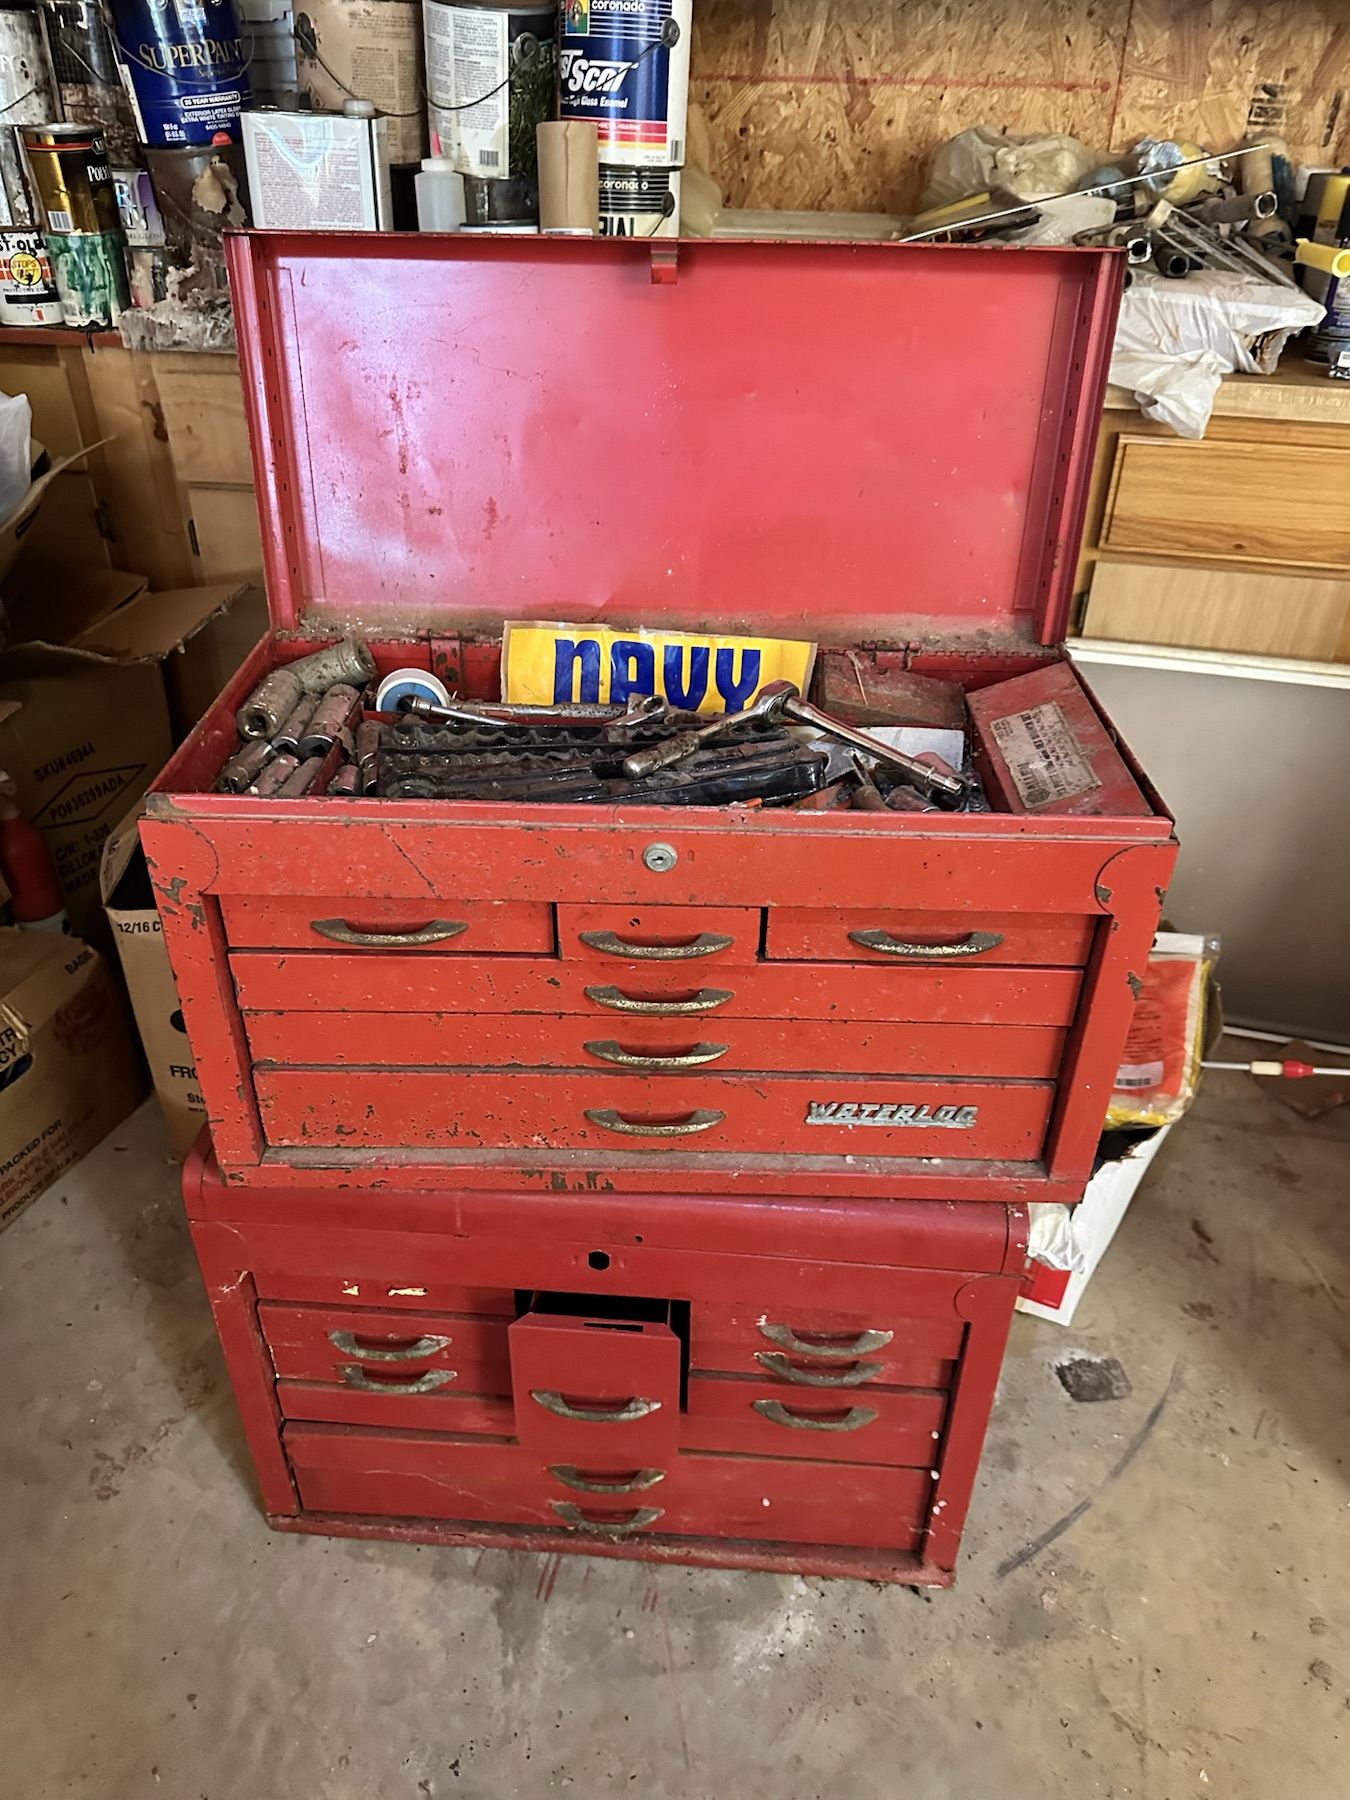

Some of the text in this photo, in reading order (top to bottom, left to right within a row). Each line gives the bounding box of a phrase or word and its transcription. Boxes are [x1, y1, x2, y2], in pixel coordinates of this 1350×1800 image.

[581, 96, 598, 107] Gloss
[599, 96, 629, 109] Enamel
[12, 259, 37, 268] STOPS
[118, 922, 149, 934] 12/16
[0, 1119, 62, 1176] PACKED FOR
[1, 1181, 43, 1219] PRODUCE
